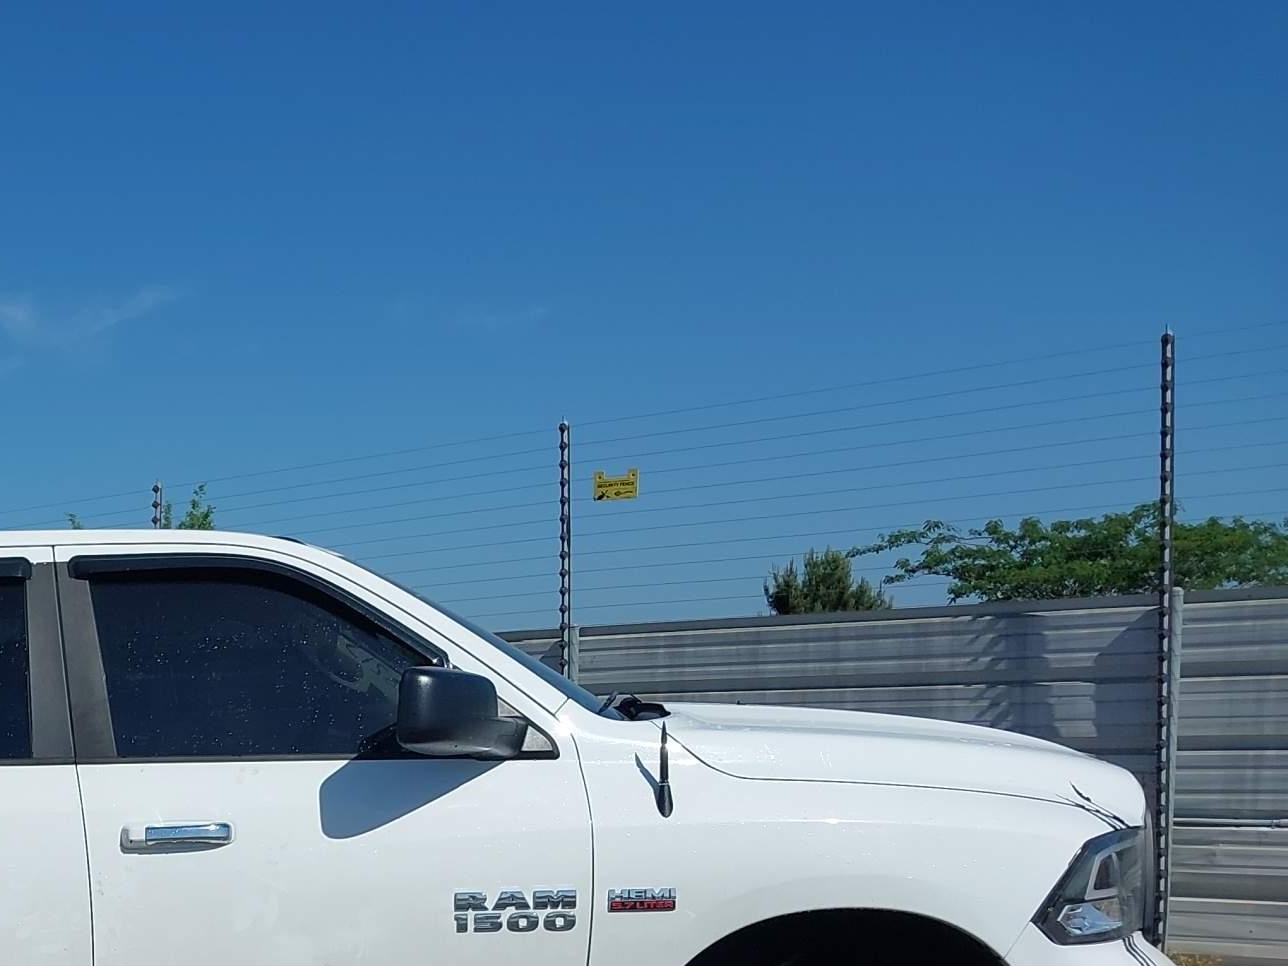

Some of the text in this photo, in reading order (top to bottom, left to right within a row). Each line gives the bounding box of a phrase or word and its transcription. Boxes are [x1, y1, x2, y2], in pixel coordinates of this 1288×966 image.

[454, 890, 576, 912] RAM
[608, 888, 676, 900] HEMI
[611, 901, 673, 909] 5.7 LITER
[454, 912, 576, 933] 1500
